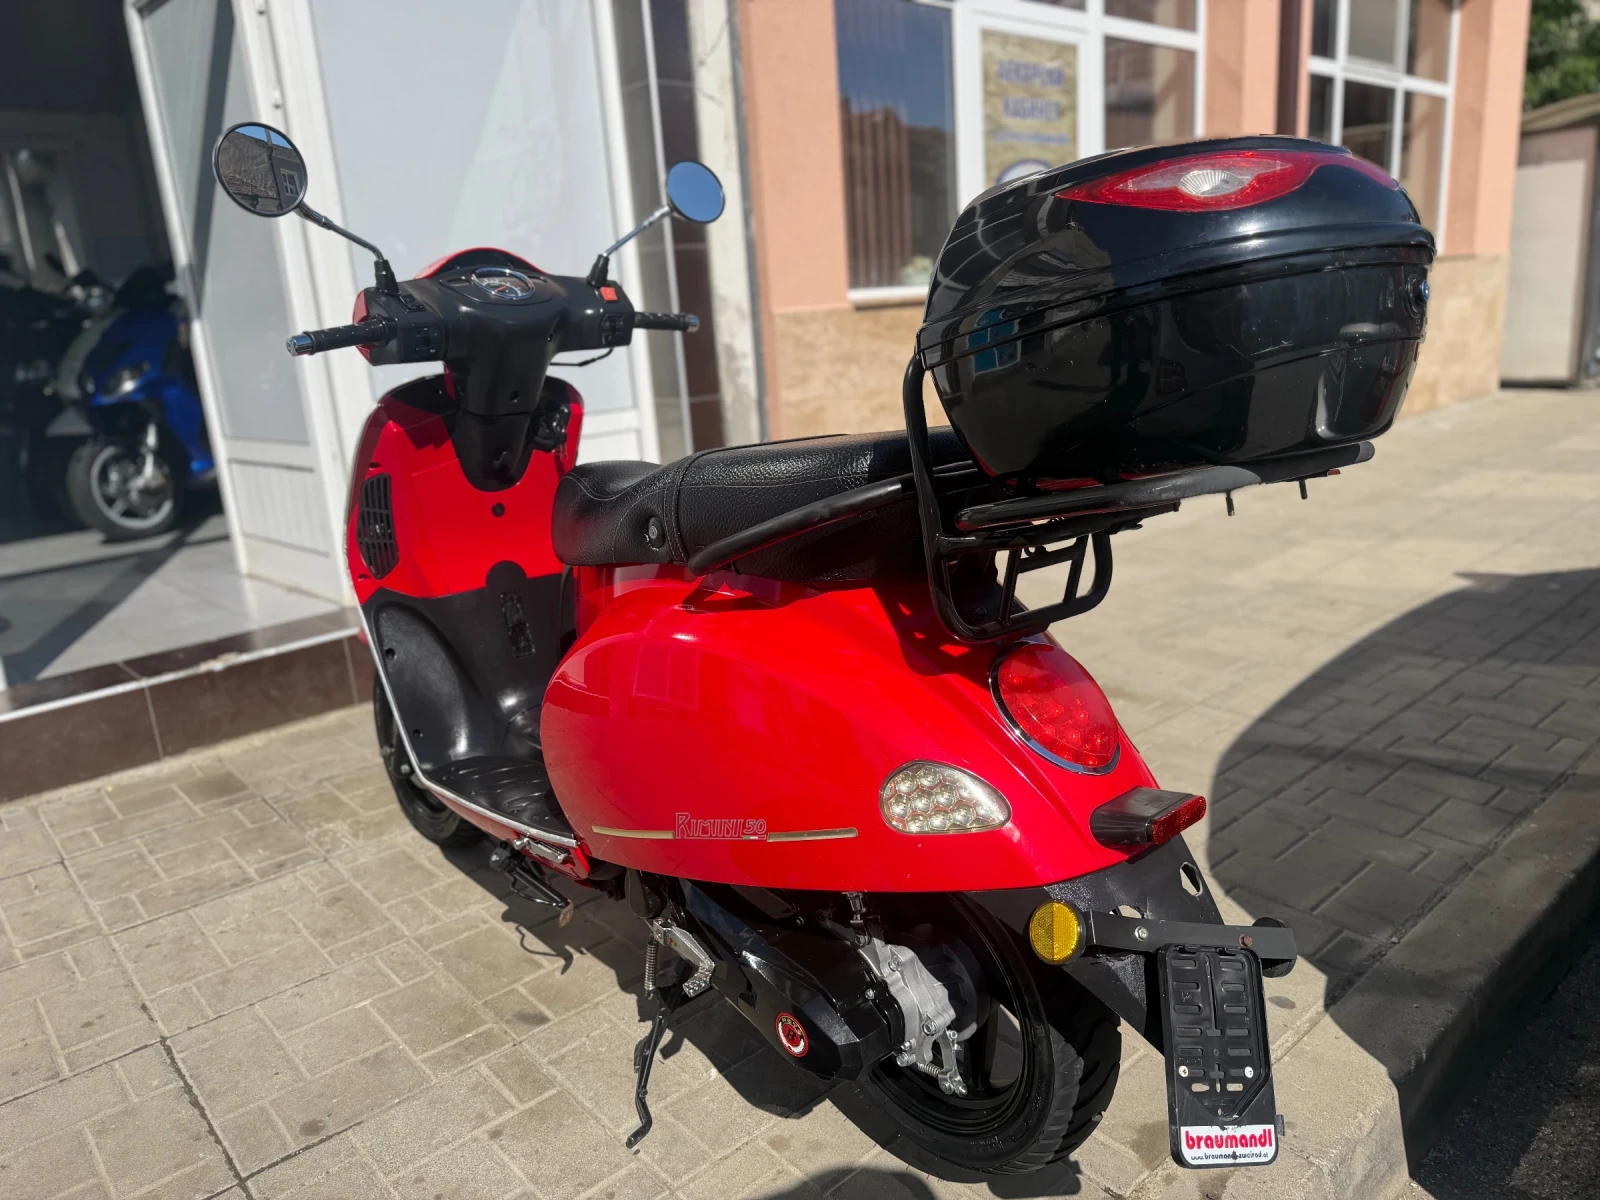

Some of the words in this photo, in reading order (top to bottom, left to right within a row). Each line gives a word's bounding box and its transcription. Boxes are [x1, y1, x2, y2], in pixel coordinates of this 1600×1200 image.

[743, 819, 767, 834] 50
[1185, 1129, 1272, 1149] braumandl
[1191, 1151, 1268, 1160] www.brauman-zweirad.at
